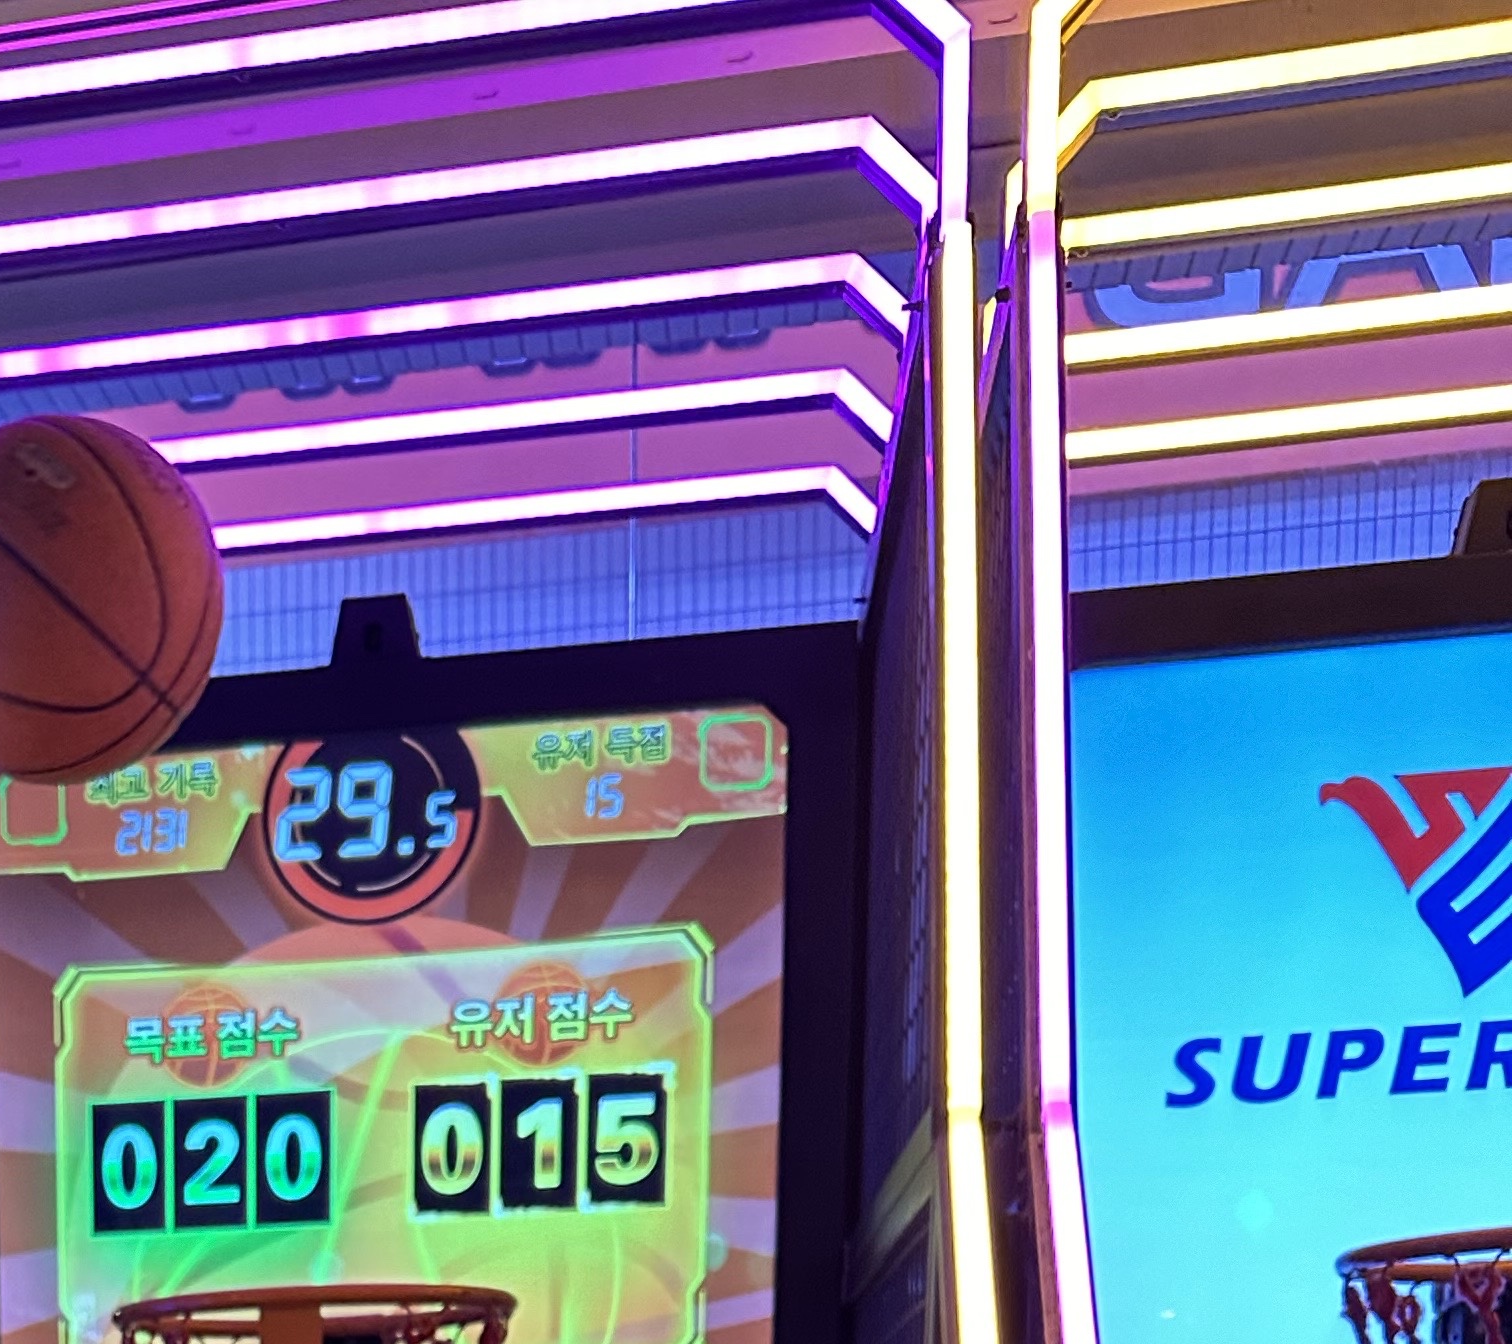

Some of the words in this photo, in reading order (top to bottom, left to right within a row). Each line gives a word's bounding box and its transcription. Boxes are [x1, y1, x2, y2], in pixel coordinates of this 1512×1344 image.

[157, 761, 218, 800] 기록
[584, 771, 624, 819] 15
[124, 1016, 206, 1064] 목표
[219, 1006, 300, 1060] 점수
[450, 1002, 536, 1050] 유저
[548, 988, 634, 1040] 점수
[1165, 1019, 1512, 1109] SUPER
